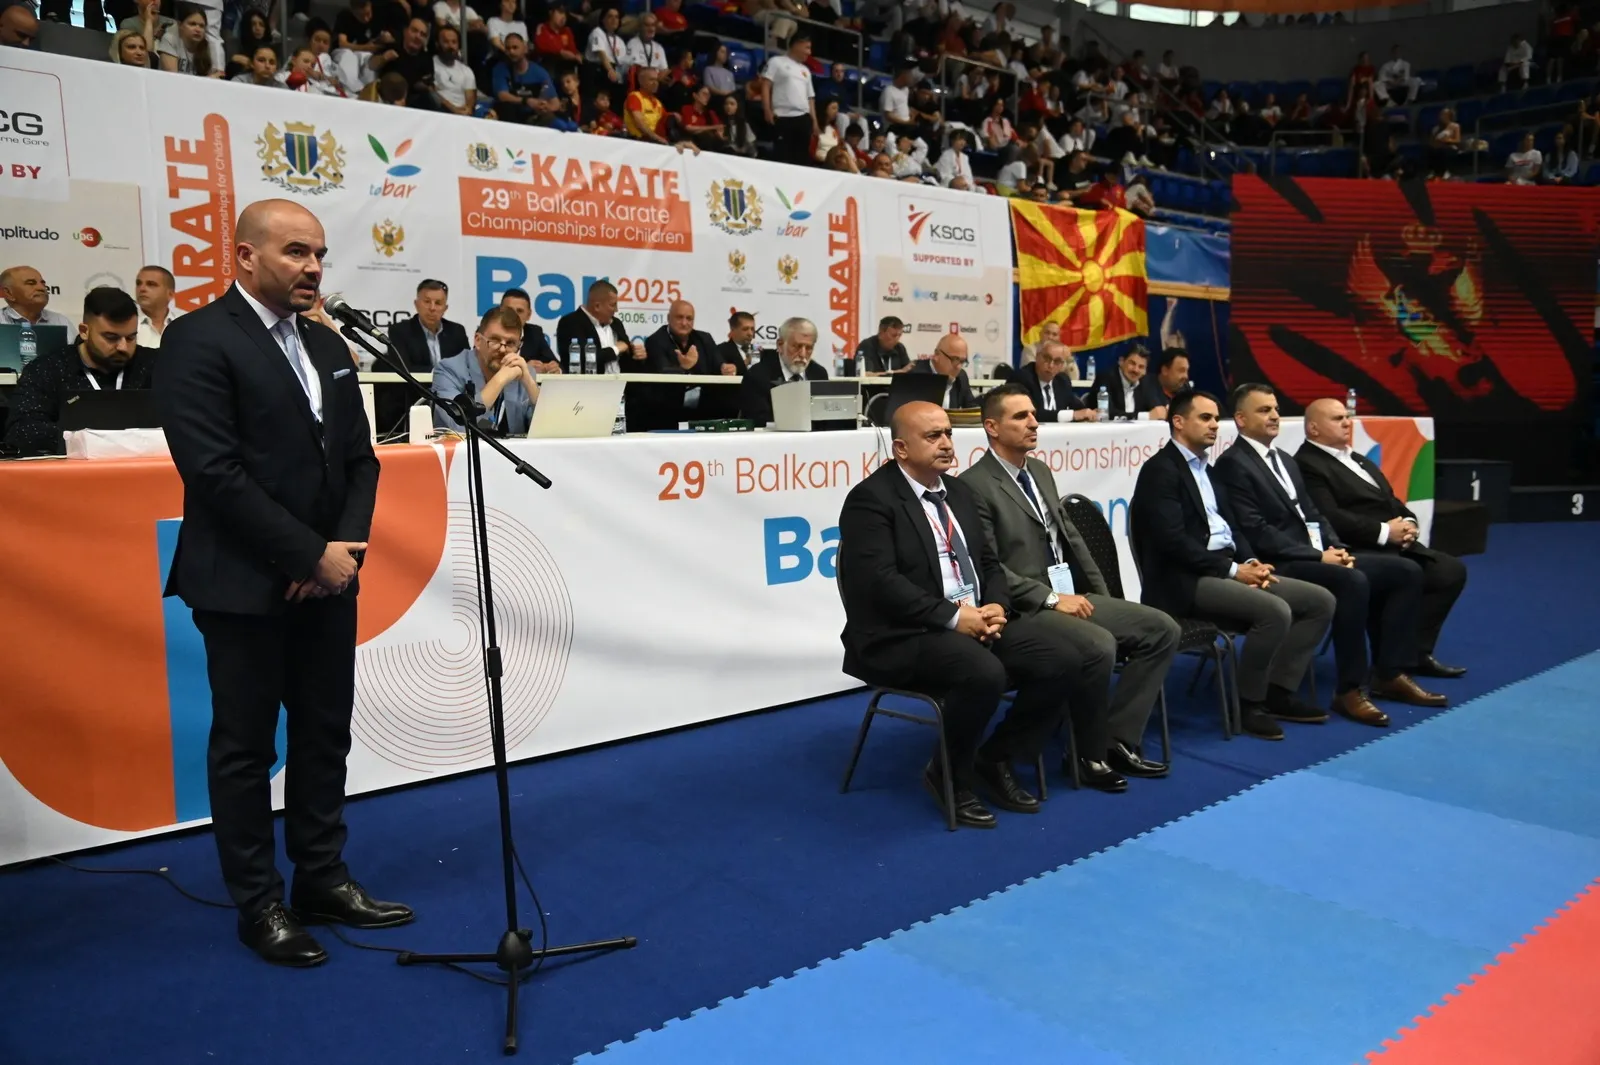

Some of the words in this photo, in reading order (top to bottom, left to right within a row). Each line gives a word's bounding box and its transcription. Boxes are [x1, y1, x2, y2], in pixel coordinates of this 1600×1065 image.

[11, 163, 42, 180] BY
[531, 153, 680, 201] KARATE
[526, 191, 598, 219] Balkan
[604, 199, 670, 225] Karate
[164, 135, 216, 313] ARATE
[467, 211, 597, 241] Championships
[601, 224, 620, 241] for
[623, 226, 685, 245] Children
[929, 223, 975, 242] KSCG
[912, 253, 962, 266] SUPPORTED
[616, 277, 682, 305] 2025
[754, 325, 778, 340] KS
[735, 453, 850, 494] Balkan
[1470, 479, 1481, 501] 1
[1571, 493, 1584, 515] 3
